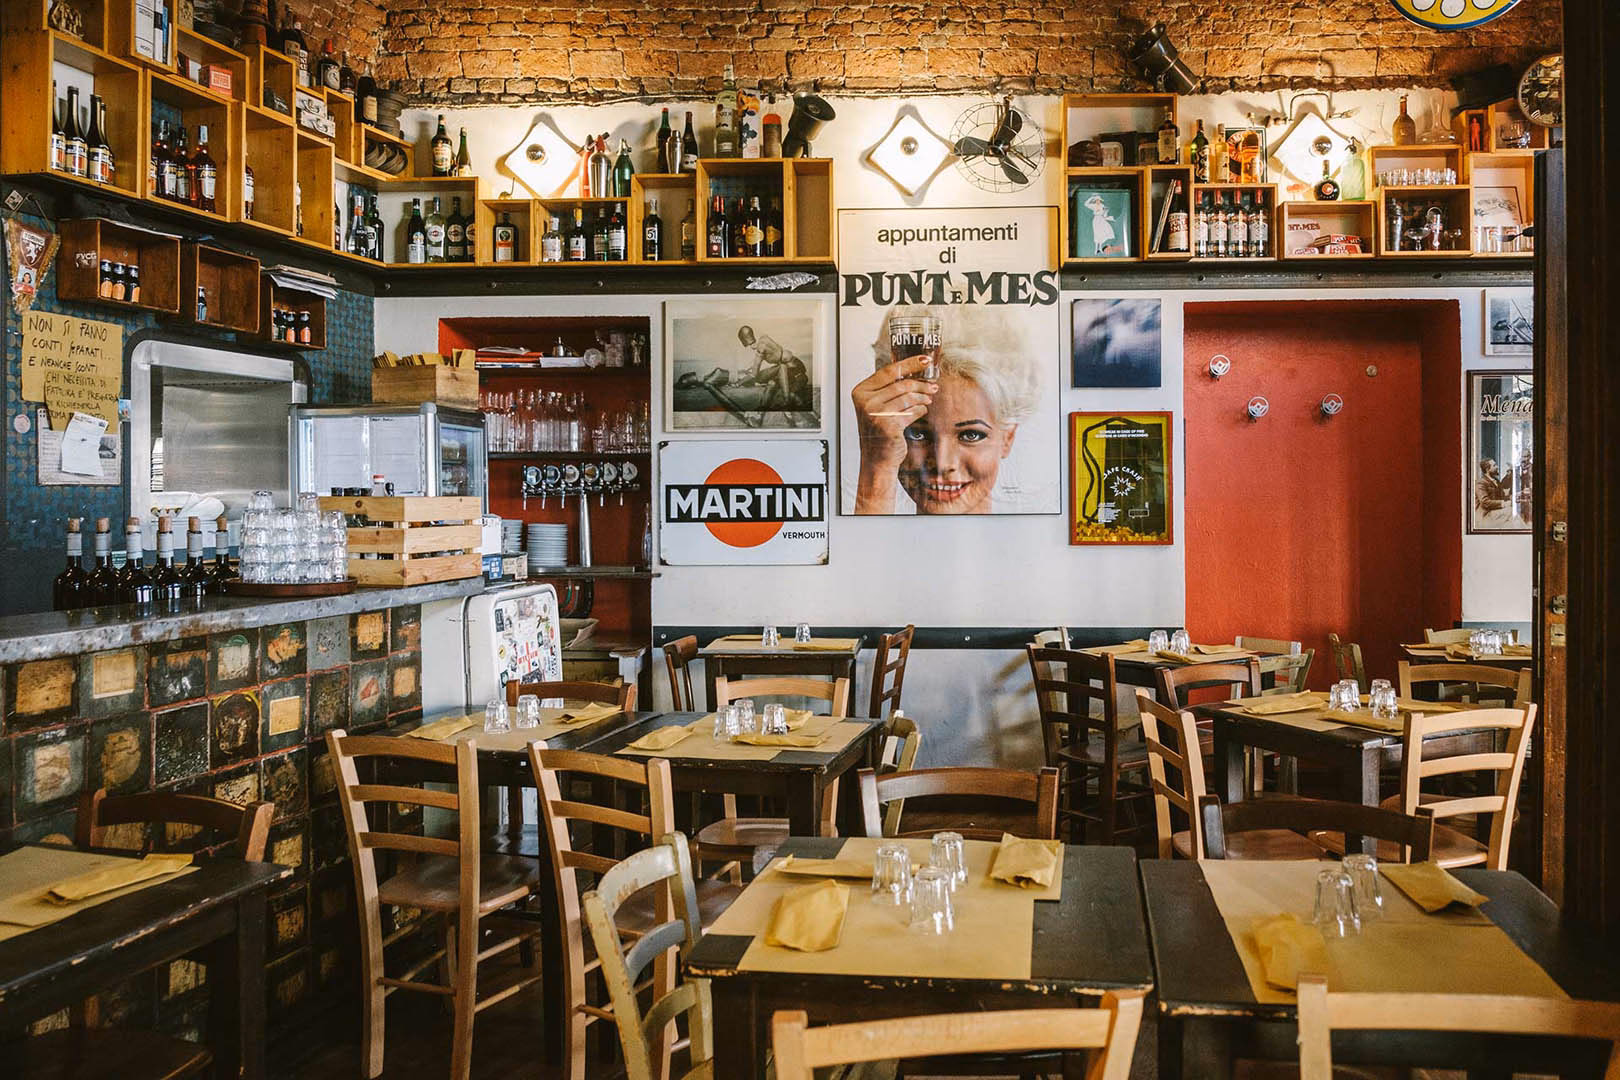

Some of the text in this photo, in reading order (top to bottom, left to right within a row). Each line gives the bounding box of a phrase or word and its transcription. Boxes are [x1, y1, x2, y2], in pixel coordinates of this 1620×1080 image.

[24, 232, 44, 245] TORINO
[877, 223, 1018, 246] appuntamenti
[939, 247, 956, 263] di
[841, 269, 1058, 307] PUNT E MES
[29, 315, 108, 342] NON SI FANNO
[32, 337, 63, 351] CONTI
[892, 333, 918, 347] PUNT
[923, 334, 942, 347] MES
[28, 356, 36, 367] E
[40, 356, 72, 371] NEANCHE
[46, 371, 60, 383] CHI
[46, 385, 75, 398] FATTURA
[670, 488, 819, 519] MARTINI
[782, 531, 825, 539] VERMOUTH
